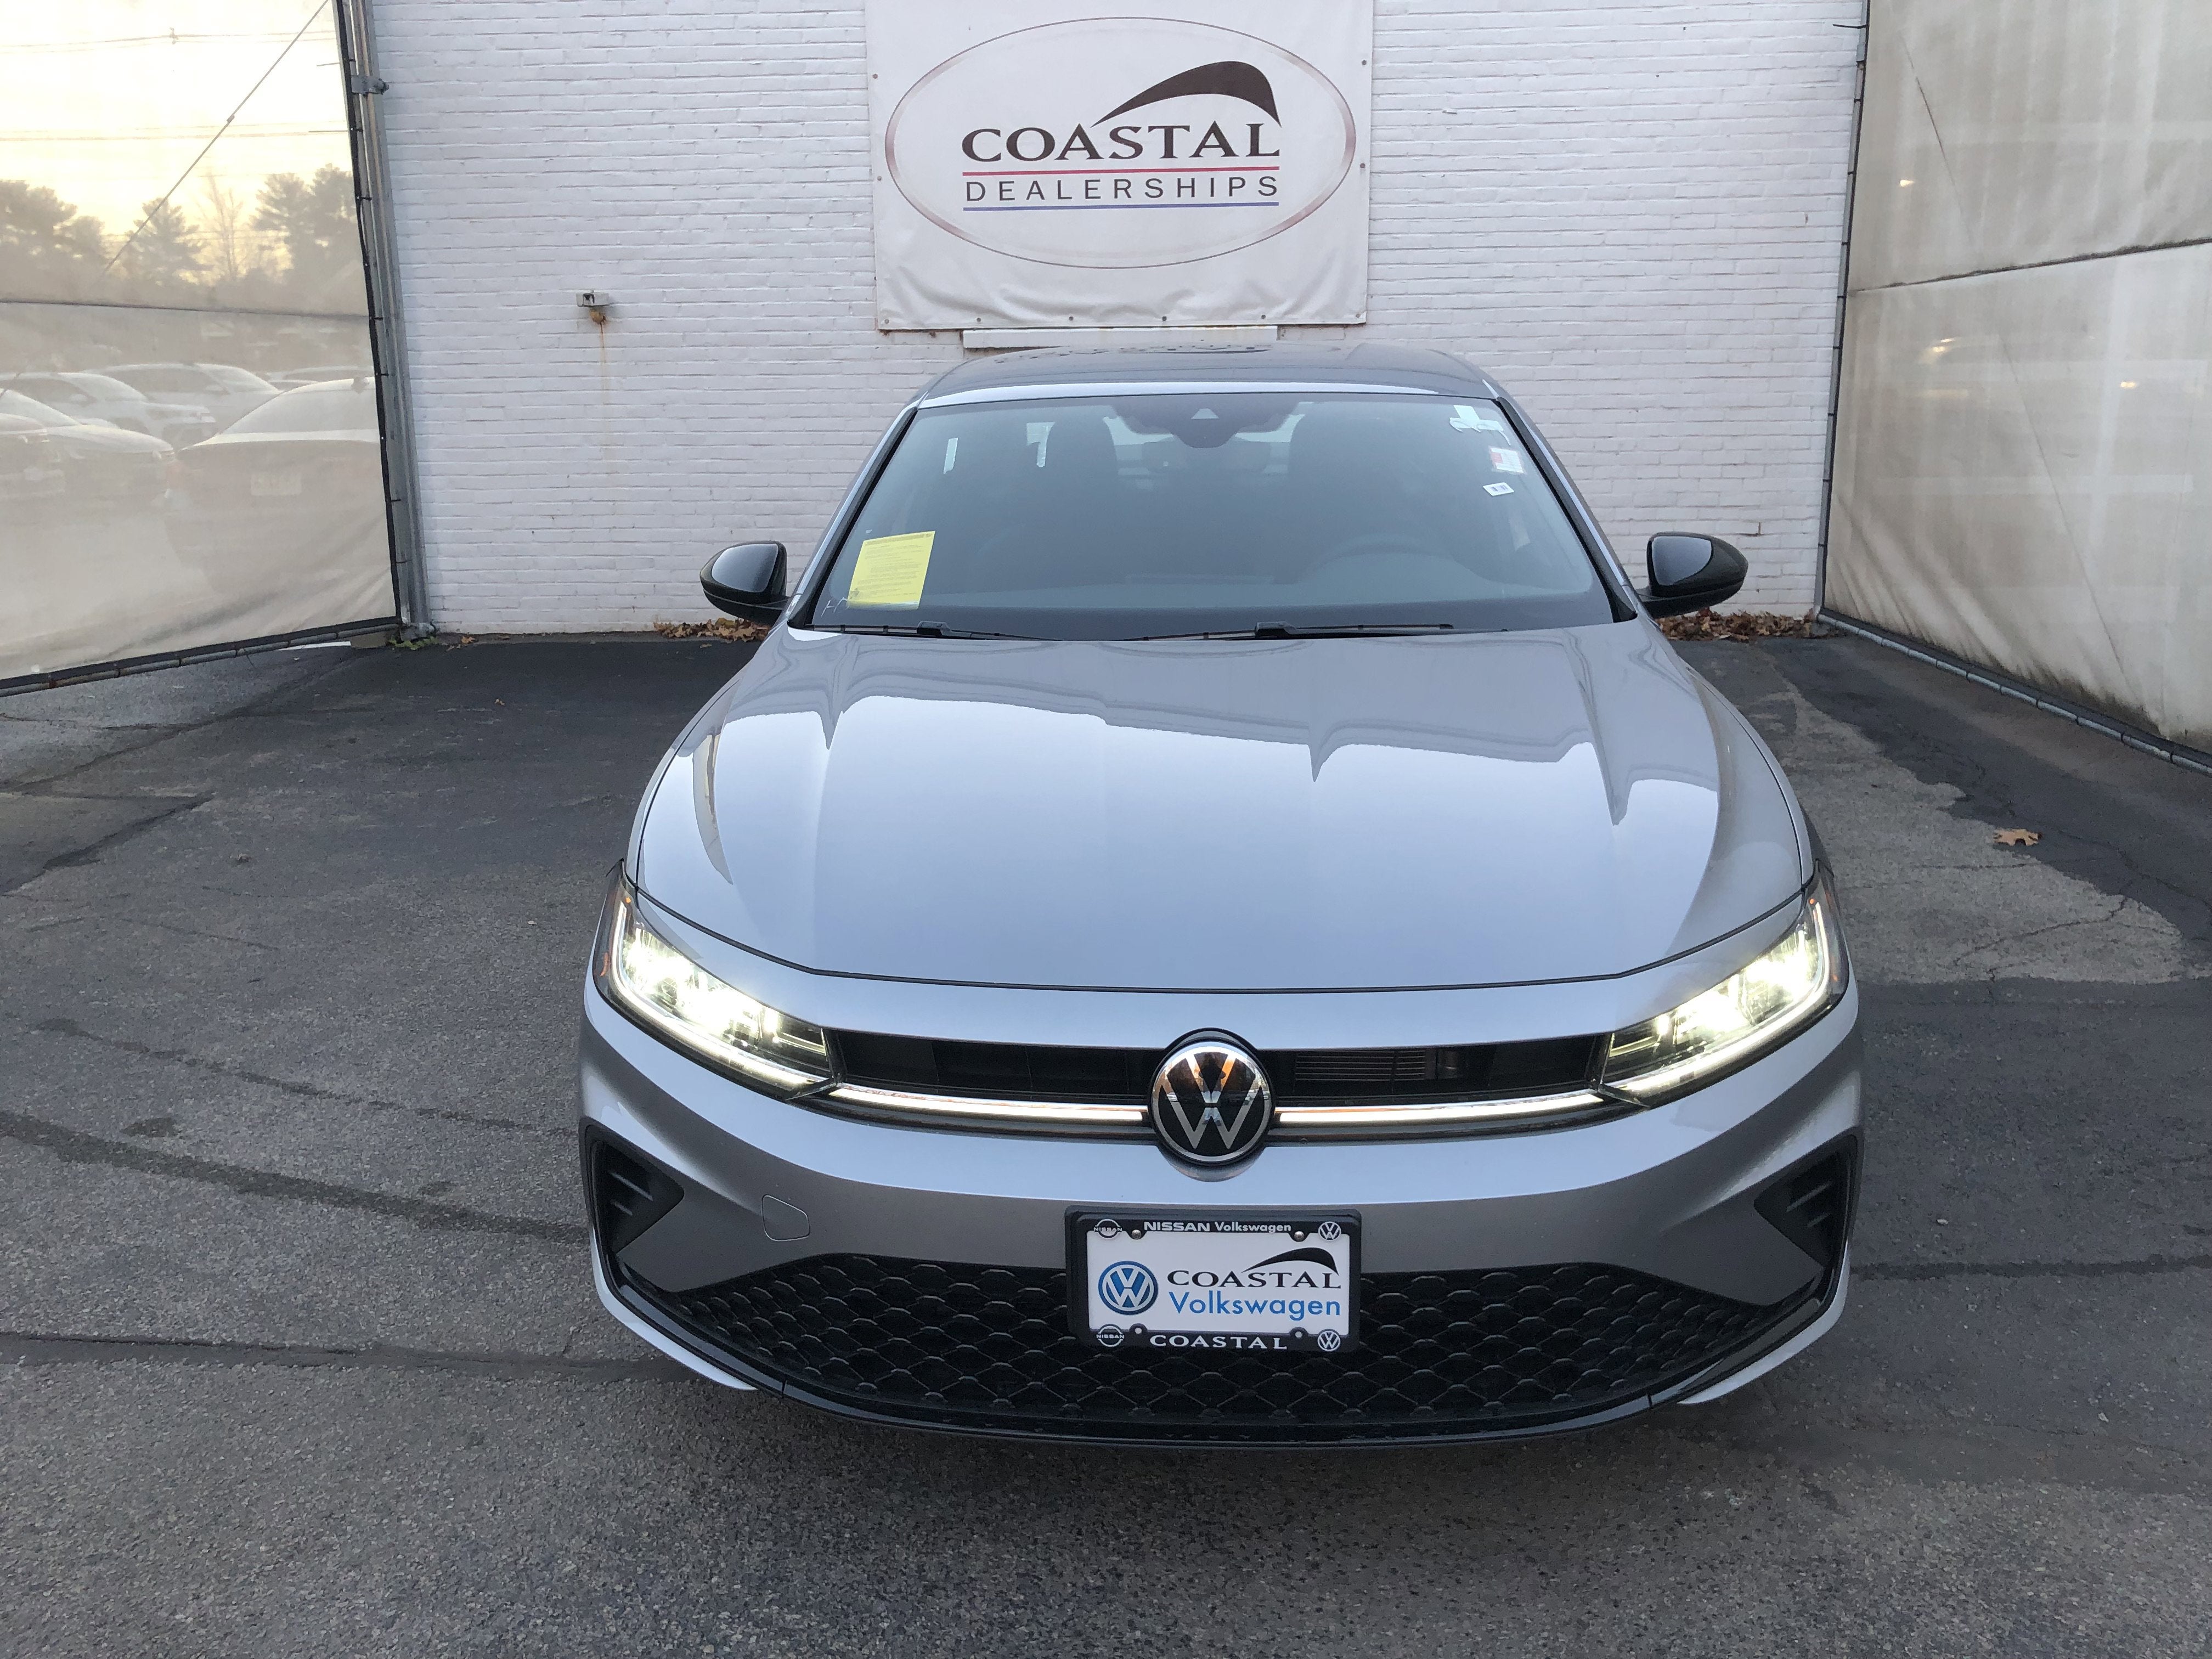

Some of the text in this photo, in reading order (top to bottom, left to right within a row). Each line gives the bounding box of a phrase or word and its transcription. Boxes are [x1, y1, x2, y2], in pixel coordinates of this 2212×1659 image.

[961, 120, 1280, 162] COASTAL
[966, 176, 1278, 201] DEALERSHIPS
[1144, 1221, 1291, 1233] NISSAN Volkswagen
[1167, 1269, 1341, 1289] COASTAL
[1169, 1290, 1341, 1321] Volkswagen
[1149, 1335, 1288, 1350] COASTAL
